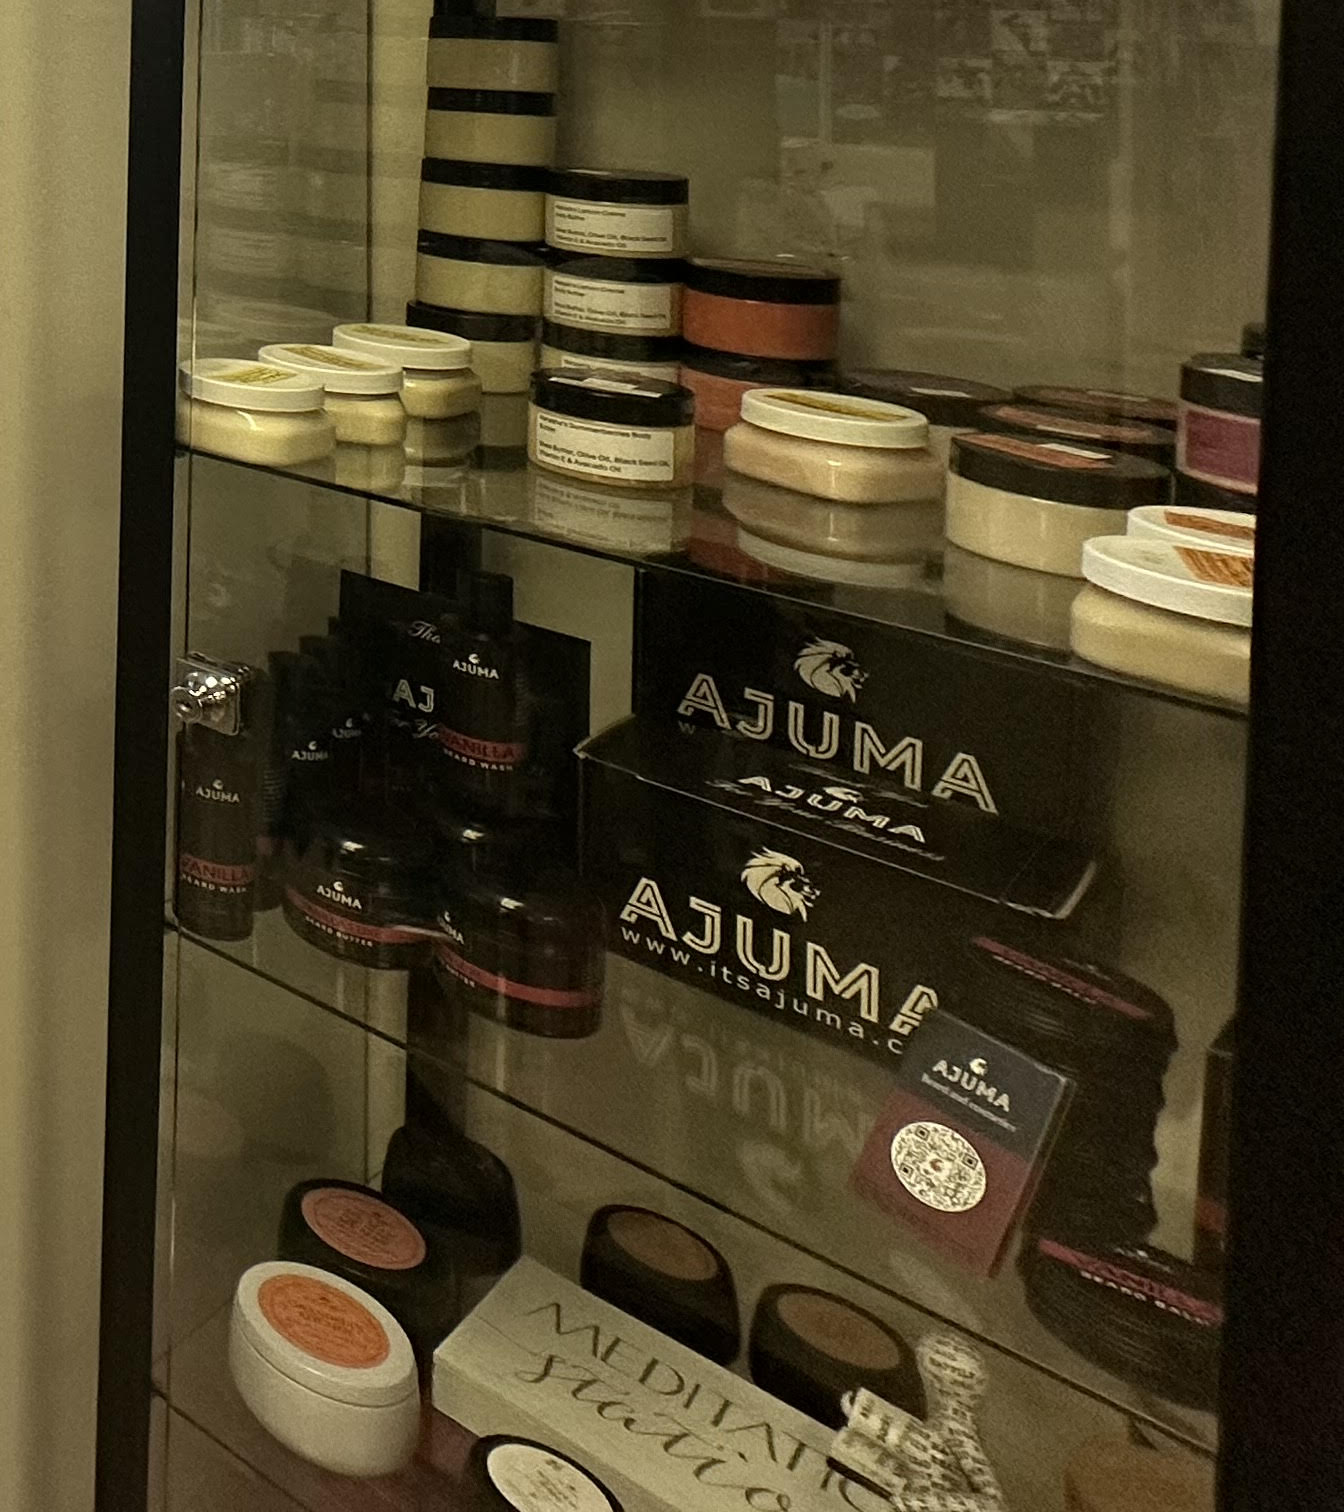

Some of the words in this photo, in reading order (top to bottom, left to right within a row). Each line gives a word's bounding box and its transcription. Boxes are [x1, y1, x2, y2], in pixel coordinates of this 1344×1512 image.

[452, 658, 500, 680] AJUMA
[676, 670, 1000, 817] AJUMA
[195, 785, 241, 804] AJUMA
[736, 775, 927, 844] AJUMA
[316, 884, 363, 910] AJUMA
[617, 875, 940, 1038] AJUMA
[619, 924, 906, 1057] www.itsajuma.c
[931, 1057, 1013, 1114] AJUMA
